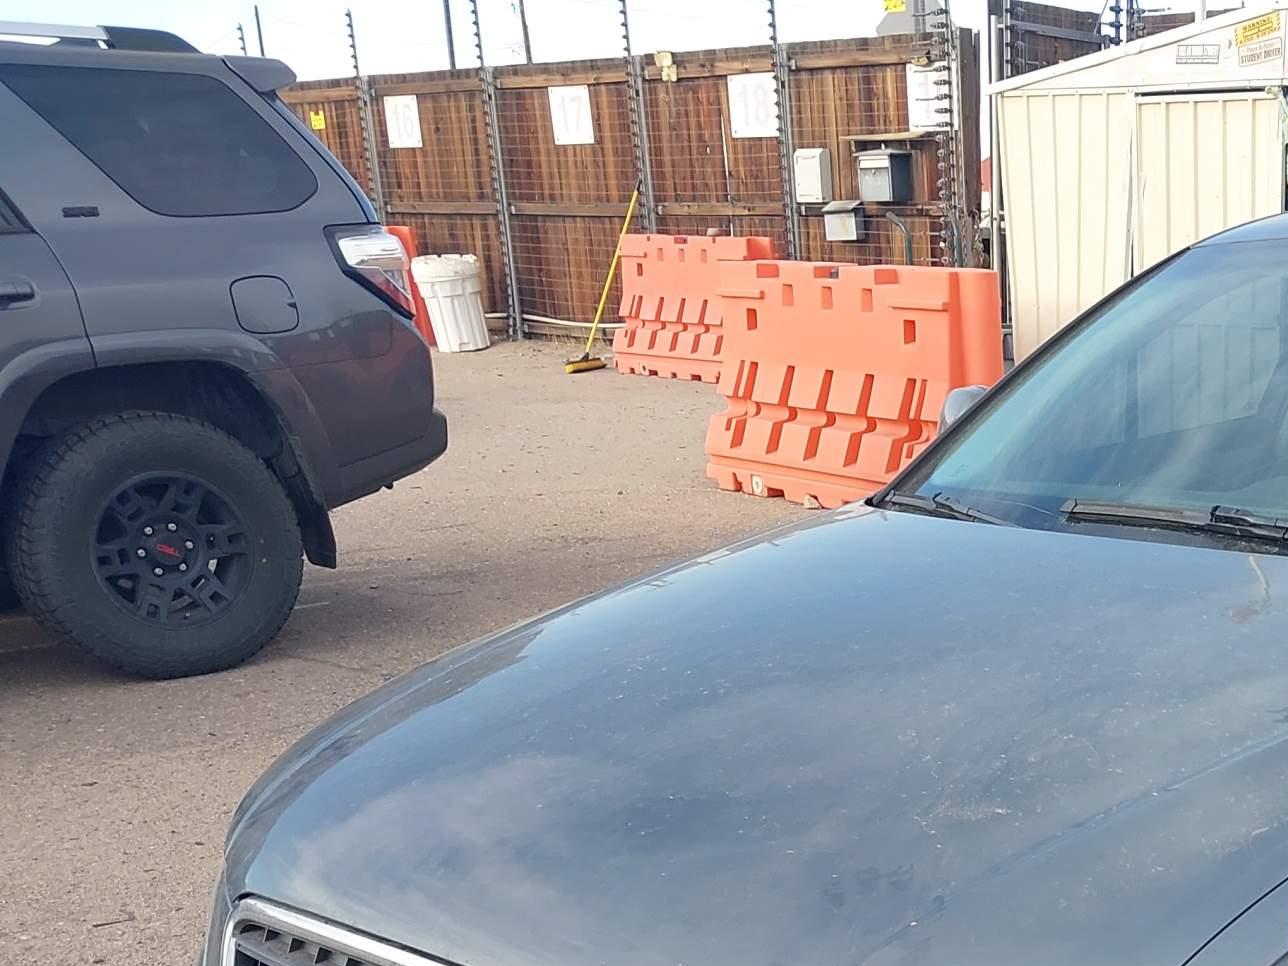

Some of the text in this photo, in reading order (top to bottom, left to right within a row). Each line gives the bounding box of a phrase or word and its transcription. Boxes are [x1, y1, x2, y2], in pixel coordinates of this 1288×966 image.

[1240, 47, 1281, 65] STUDENT DRIVER
[391, 103, 414, 141] 16
[558, 95, 583, 136] 17
[737, 82, 769, 127] 18
